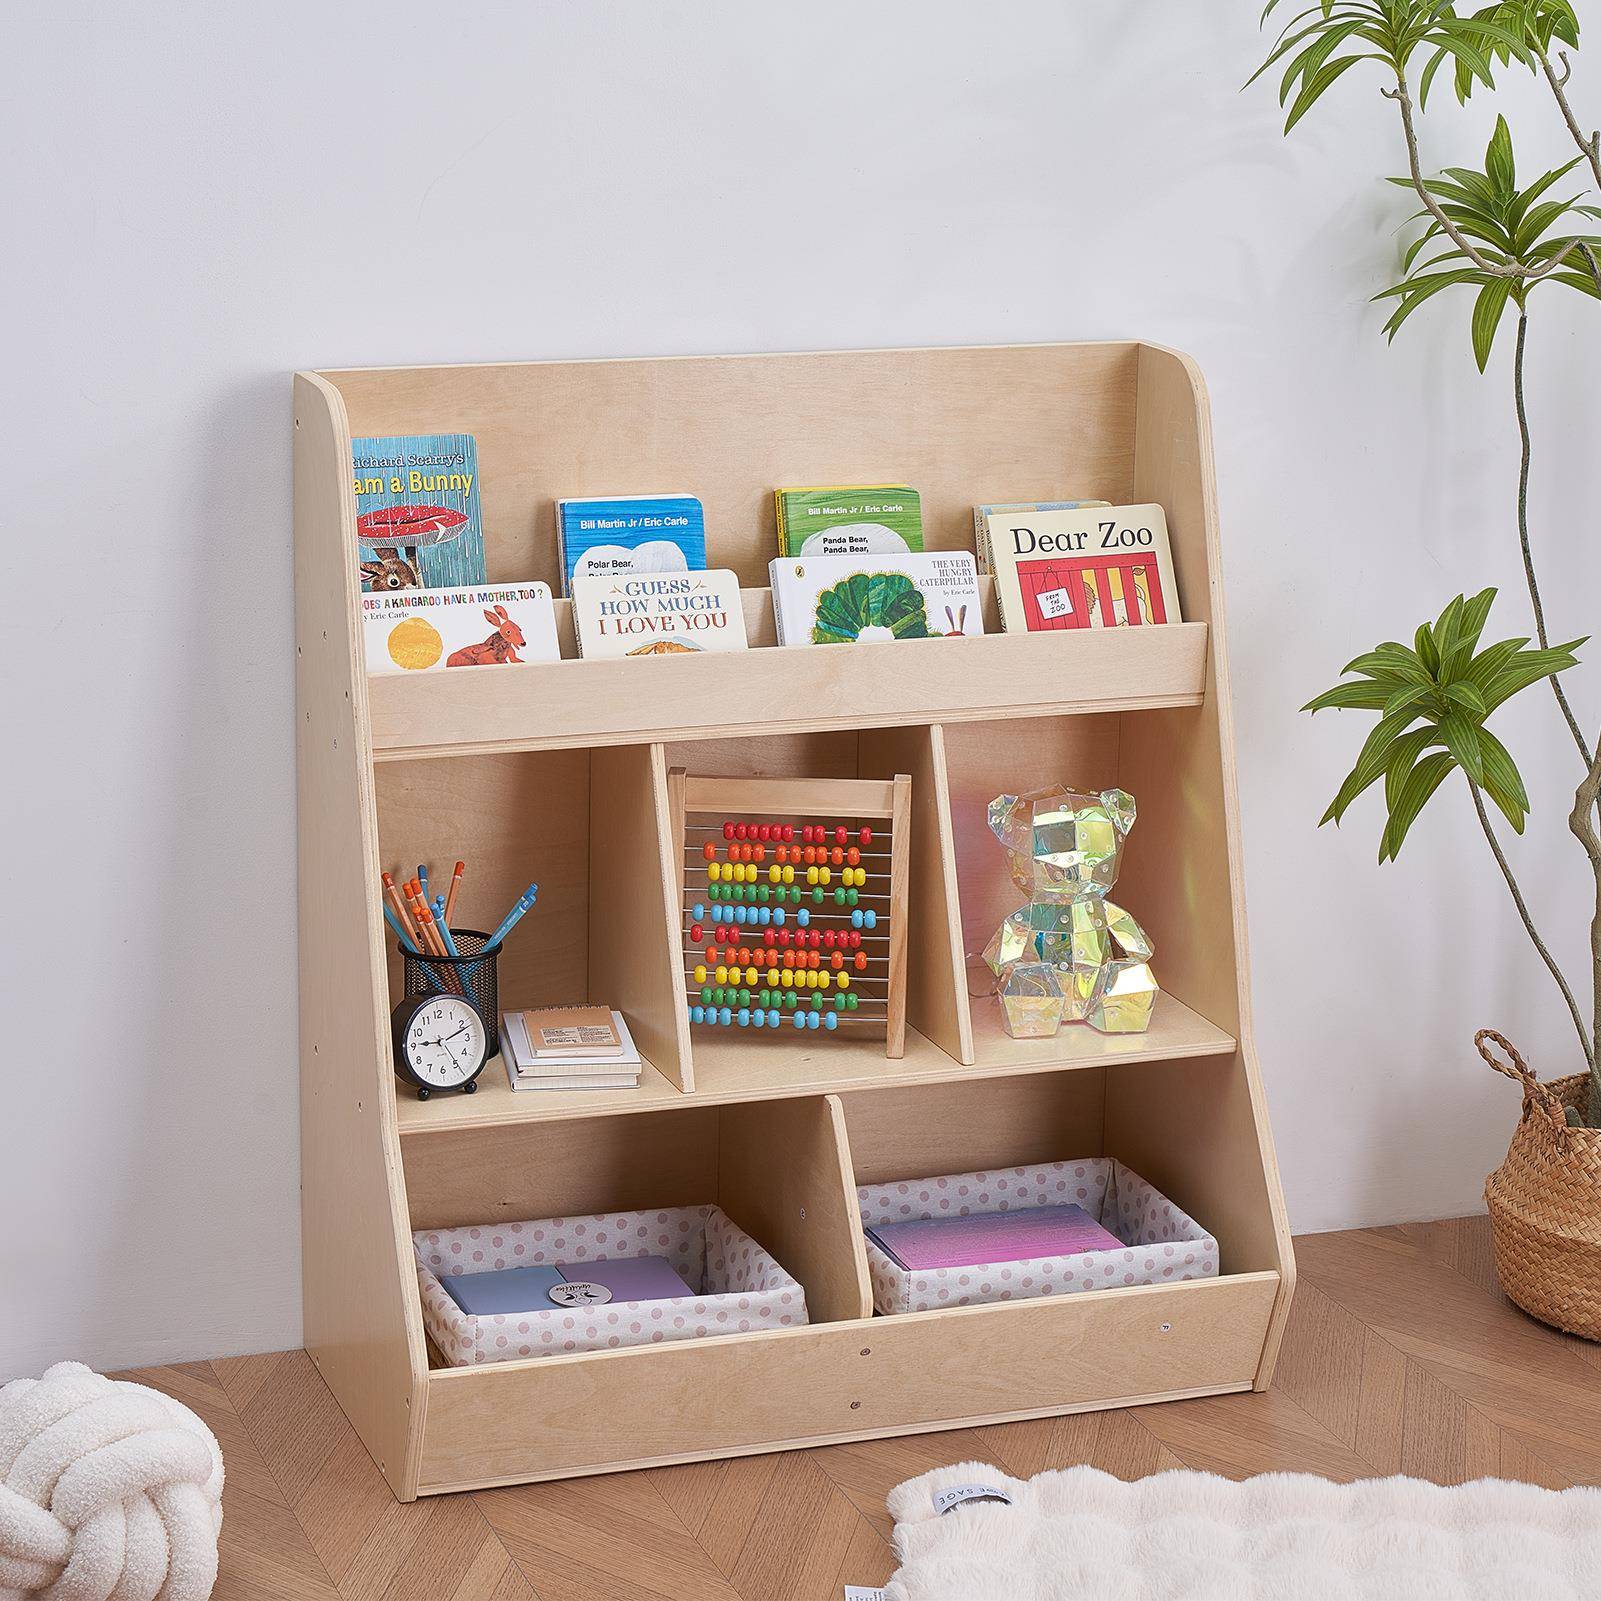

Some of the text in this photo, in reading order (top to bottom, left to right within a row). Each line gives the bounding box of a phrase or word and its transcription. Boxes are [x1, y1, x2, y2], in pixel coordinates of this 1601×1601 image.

[407, 453, 464, 467] Scarry's
[352, 470, 473, 497] am a Bunny
[807, 507, 821, 516] Bill
[822, 506, 848, 515] Martin
[849, 506, 858, 514] Jr
[865, 505, 881, 513] Eric
[882, 504, 903, 512] Carle
[580, 516, 689, 530] Bill Martin Jr / Eric Carle
[822, 535, 869, 545] Panda Bear,
[1009, 527, 1088, 555] Dear
[1098, 521, 1153, 548] Zoo
[823, 545, 869, 555] Panda Bear,
[587, 559, 634, 570] Polar Bear,
[931, 559, 972, 569] THE VERY
[939, 568, 973, 578] HUNGRY
[919, 576, 974, 587] CATERPILLAR
[624, 578, 692, 597] GUESS
[363, 599, 381, 610] OES
[384, 598, 391, 609] A
[391, 595, 442, 609] KANGAROO
[443, 594, 467, 606] HAVE
[469, 593, 475, 604] A
[600, 594, 722, 616] HOW MUCH
[1050, 603, 1066, 614] ZOO
[370, 612, 387, 620] Eric
[388, 610, 409, 619] Carle
[598, 611, 727, 636] I LOVE YOU
[433, 1009, 443, 1019] 12
[449, 1011, 453, 1020] 1
[421, 1016, 430, 1026] 11
[458, 1019, 465, 1029] 2
[413, 1028, 423, 1037] 10
[464, 1032, 471, 1042] 3
[410, 1042, 416, 1051] 9
[461, 1047, 468, 1056] 4
[415, 1055, 422, 1065] 8
[452, 1060, 459, 1069] 5
[427, 1063, 433, 1073] 7
[439, 1065, 446, 1075] 6
[938, 1487, 974, 1505] SAGE
